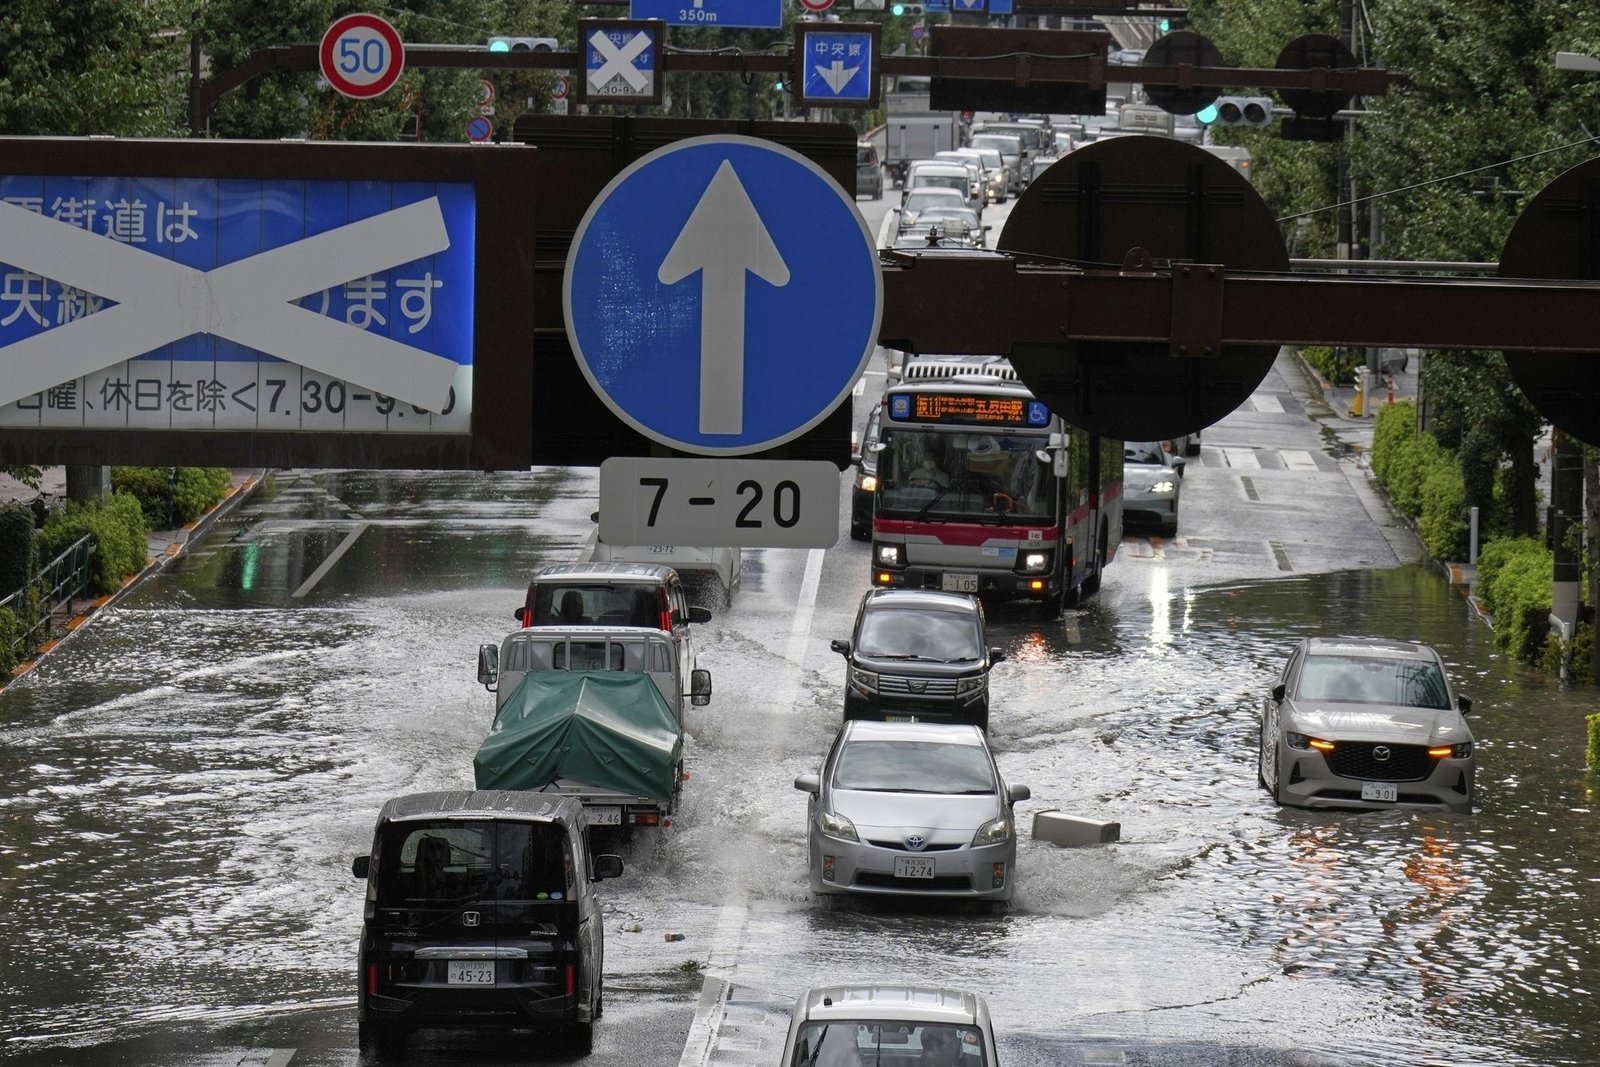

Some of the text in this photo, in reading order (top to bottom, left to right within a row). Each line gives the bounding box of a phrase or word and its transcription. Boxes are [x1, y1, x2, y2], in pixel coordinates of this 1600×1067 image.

[679, 9, 717, 21] 350m
[340, 38, 384, 74] 50
[3, 197, 199, 243] 街道は
[905, 866, 932, 877] 12-74
[458, 970, 492, 982] 45-23
